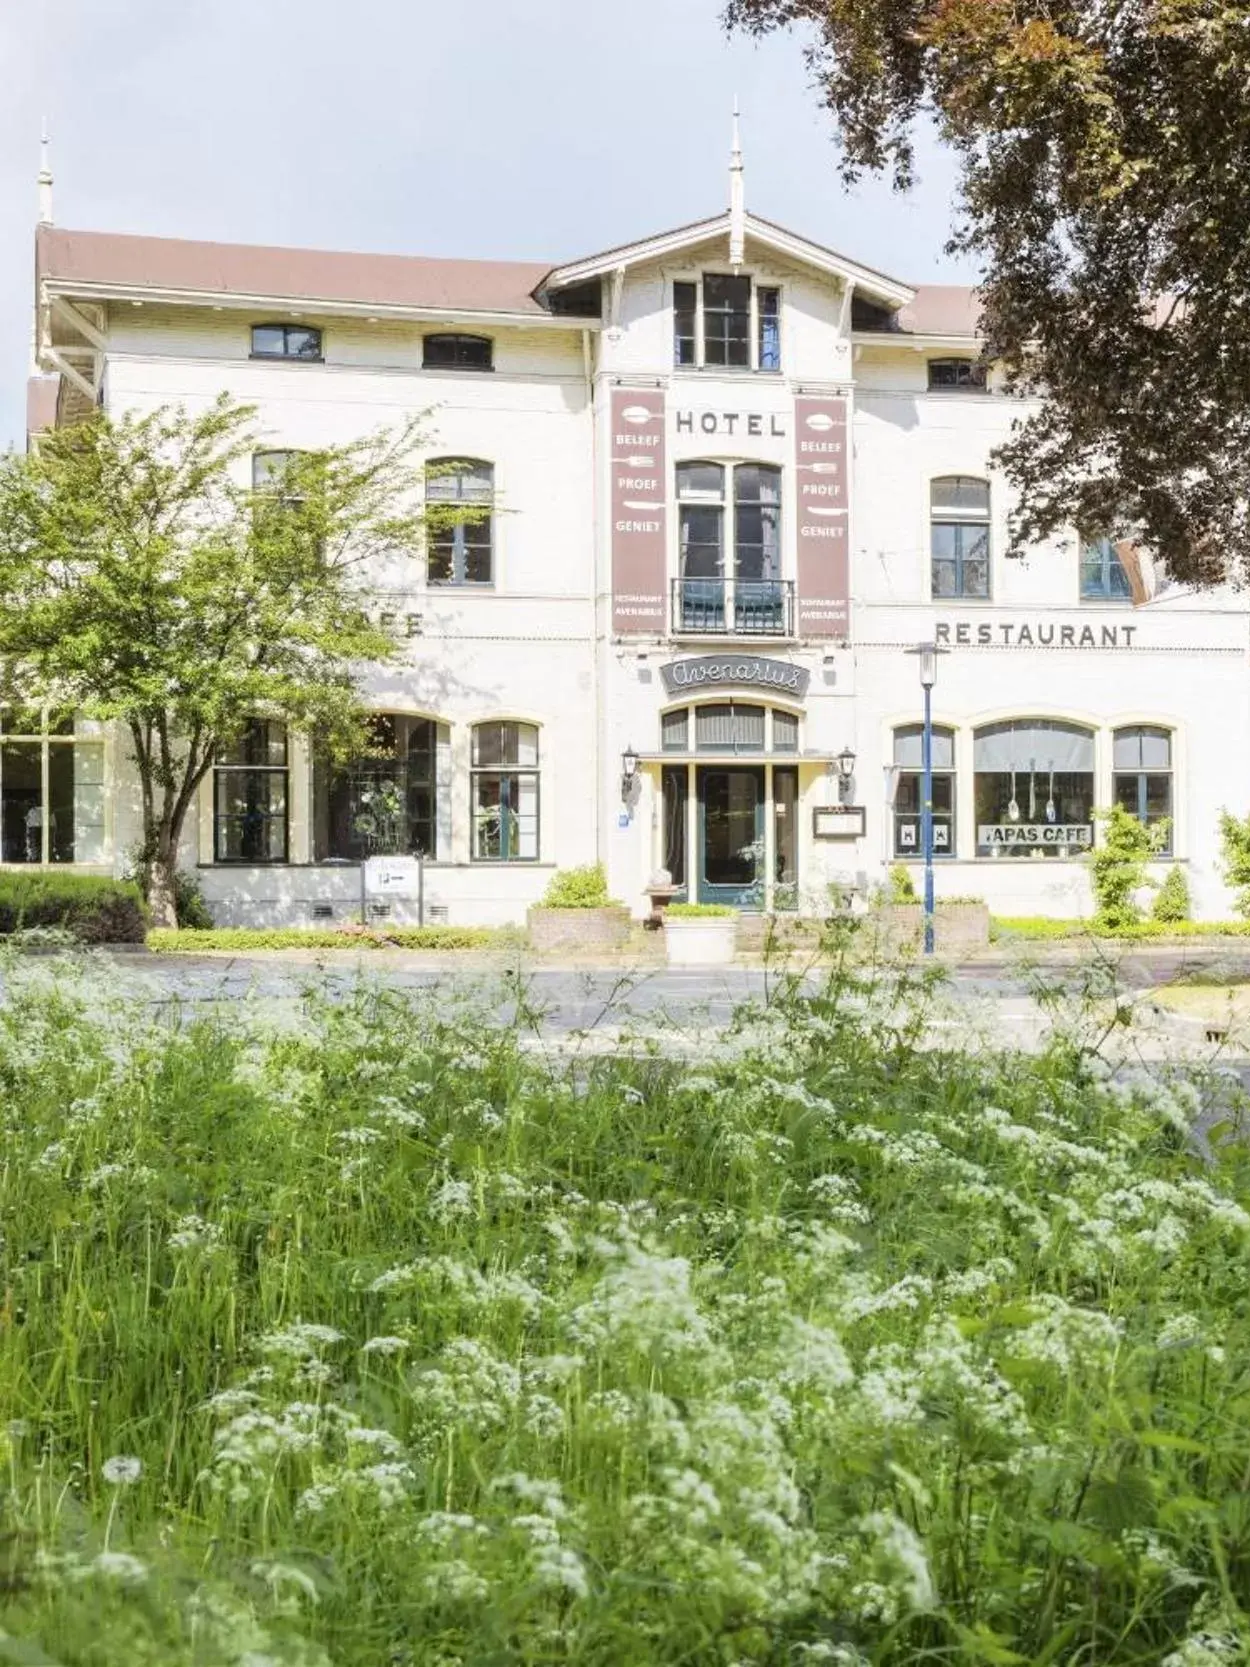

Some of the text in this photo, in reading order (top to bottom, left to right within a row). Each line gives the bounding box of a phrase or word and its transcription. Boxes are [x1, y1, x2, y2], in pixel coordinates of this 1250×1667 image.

[676, 411, 785, 436] HOTEL
[616, 434, 660, 446] BELEEF
[617, 478, 658, 490] PROEF
[802, 484, 841, 496] PROEF
[616, 520, 660, 532] GENIET
[800, 526, 844, 537] GENIET
[935, 623, 1137, 646] RESTAURANT
[672, 661, 801, 688] Avenarius
